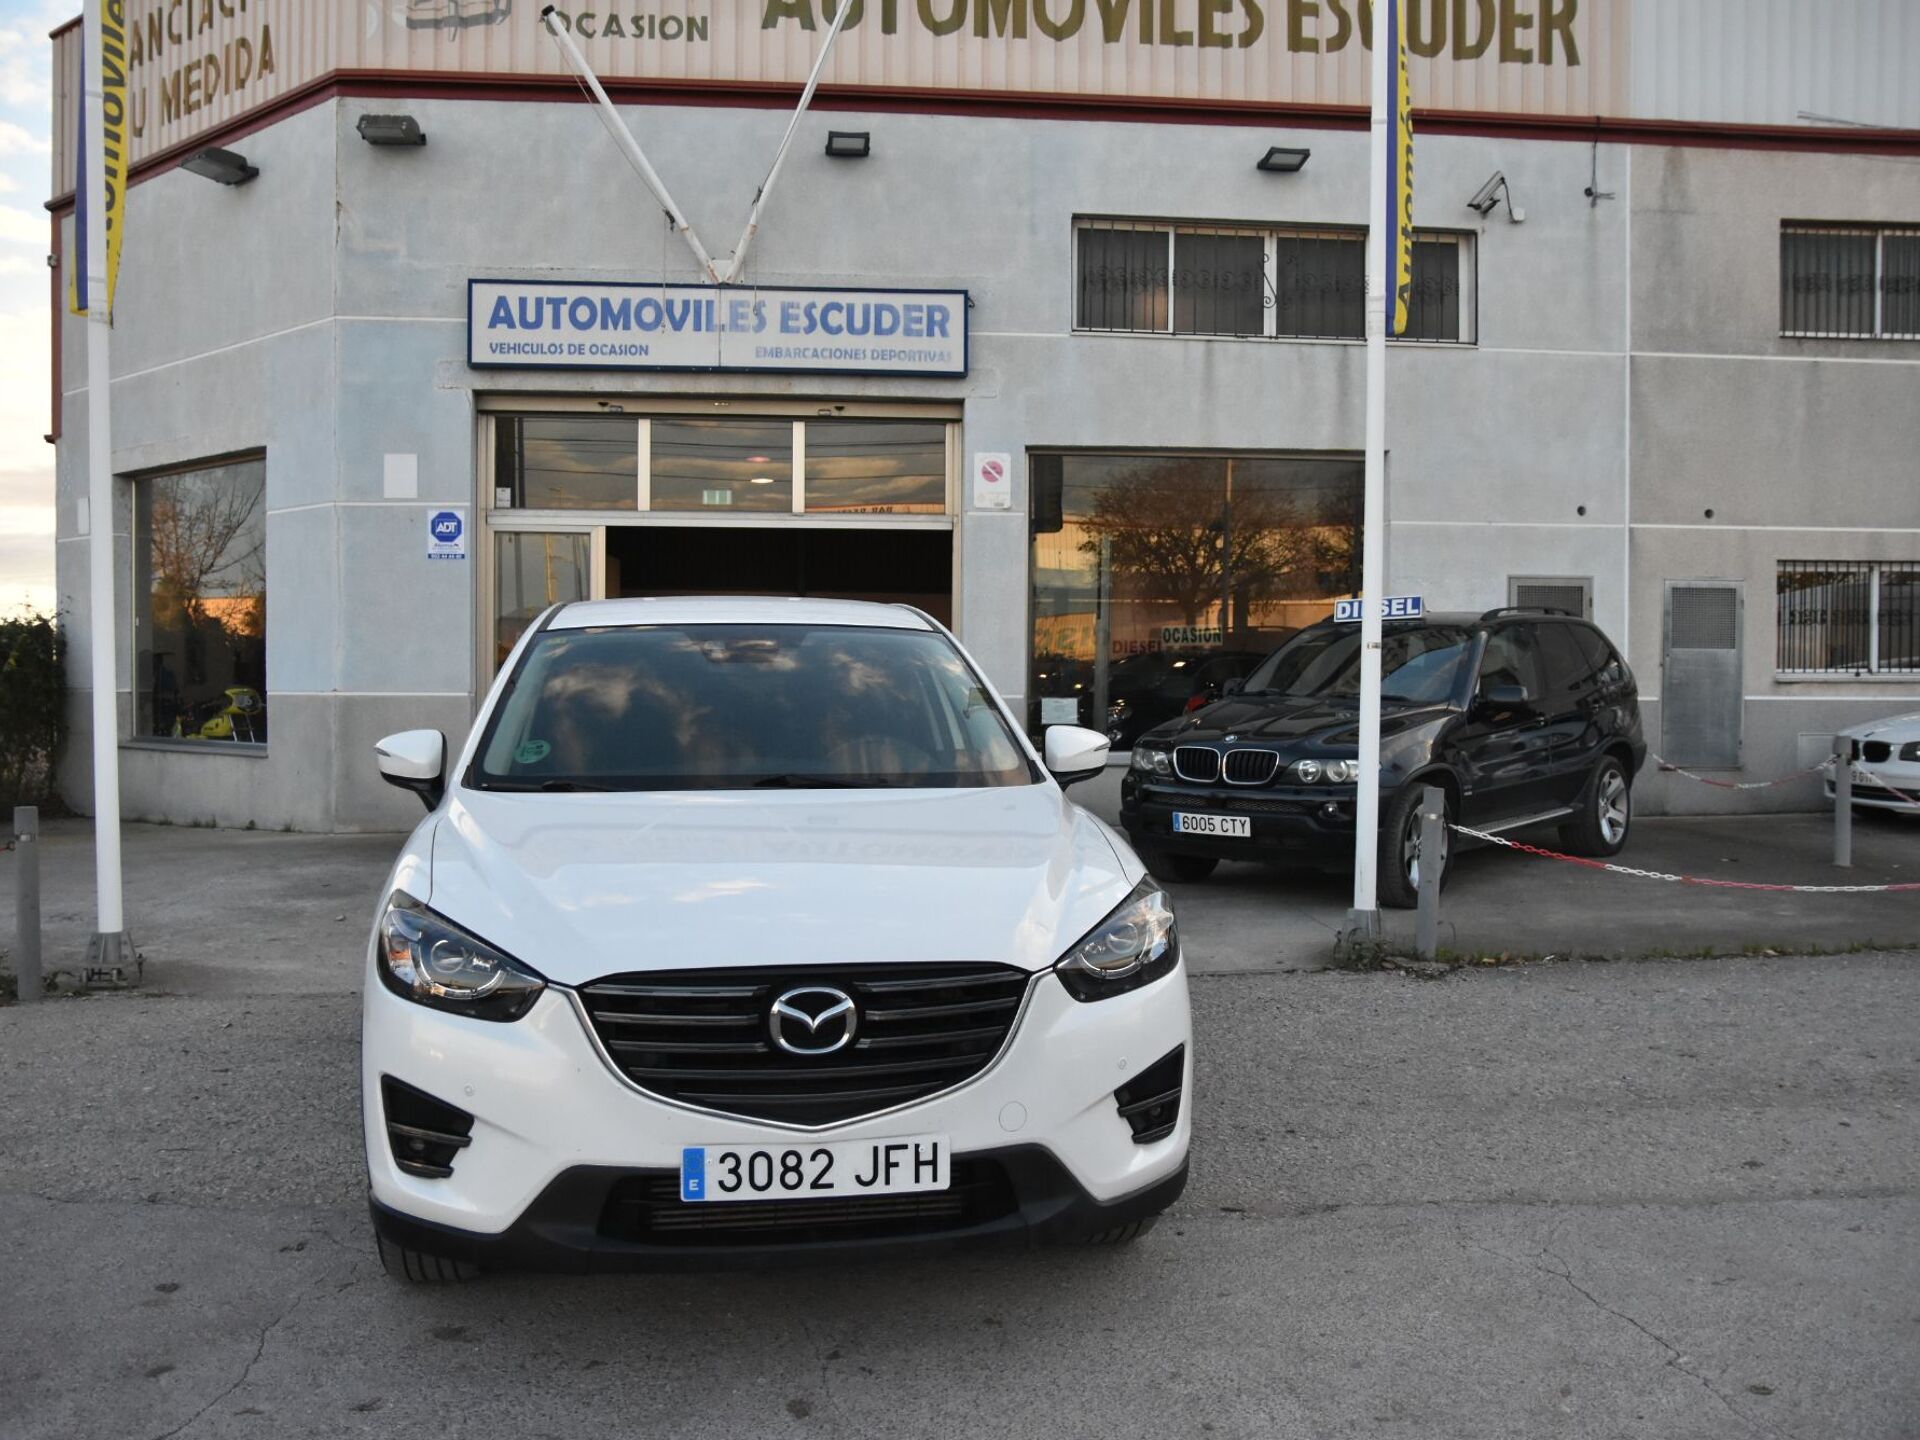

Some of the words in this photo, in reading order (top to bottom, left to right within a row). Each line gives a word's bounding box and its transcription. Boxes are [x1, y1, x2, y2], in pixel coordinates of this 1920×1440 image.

[546, 11, 708, 42] OCASION
[1287, 0, 1581, 66] ESUDER
[161, 24, 274, 126] MEDIDA
[488, 295, 767, 333] AUTOMOVILES
[780, 301, 950, 338] ESCUDER
[489, 343, 564, 356] VEHICULOS
[568, 344, 586, 356] DE
[589, 344, 649, 357] OCASION
[755, 346, 866, 361] EMBARCACIONES
[871, 349, 951, 363] DEPORTIVAS
[435, 521, 458, 533] ADT
[1336, 598, 1419, 619] DISEL
[1163, 627, 1221, 643] OCASION
[1182, 815, 1215, 832] 6005
[1221, 818, 1247, 834] CTY
[689, 1179, 699, 1191] E
[718, 1148, 834, 1192] 3082
[855, 1142, 938, 1187] JFH
